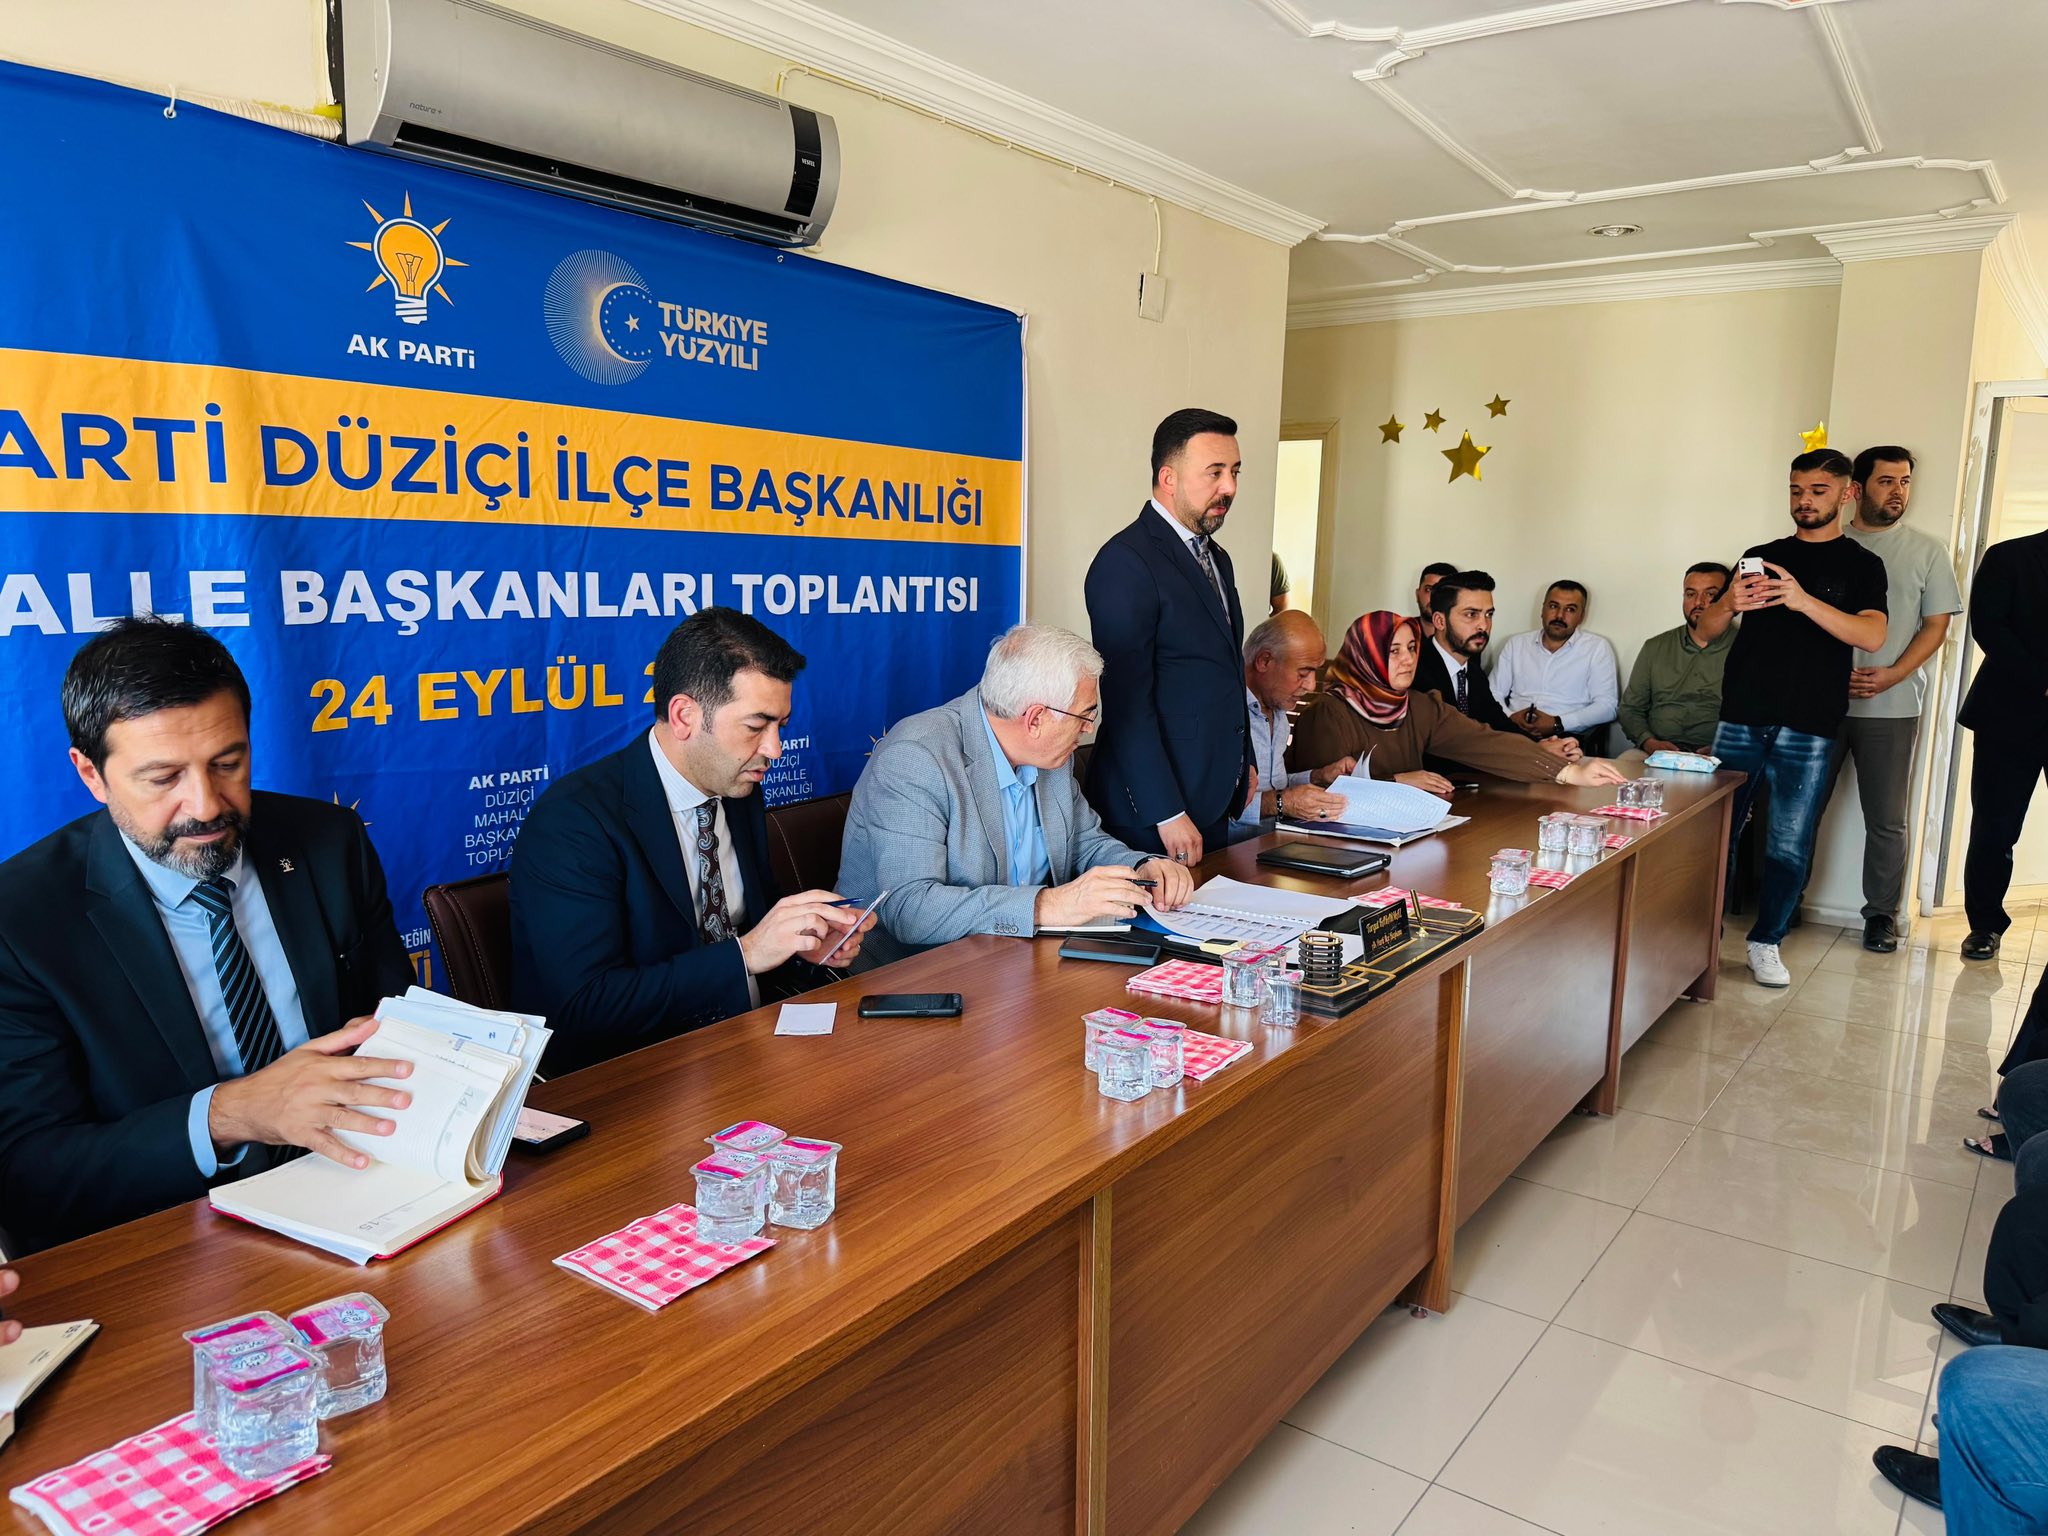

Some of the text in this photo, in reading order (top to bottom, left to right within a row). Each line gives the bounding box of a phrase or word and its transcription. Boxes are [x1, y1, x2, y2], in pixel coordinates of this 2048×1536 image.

[347, 334, 389, 359] AK
[659, 330, 759, 371] YÜZYILI
[0, 402, 983, 527] ARTİ DÜZİÇİ İLÇE BAŞKANLIĞI
[0, 569, 979, 637] ALLE BAŞKANLARI TOPLANTISI
[310, 675, 393, 732] 24
[418, 655, 624, 721] EYLÜL
[780, 735, 810, 751] ARTİ
[469, 764, 549, 790] AK PARTİ
[485, 786, 535, 808] DÜZİÇİ
[764, 781, 813, 802] ŞKANLIĞI
[475, 806, 530, 828] MAHAL
[465, 826, 520, 848] BAŞKA
[466, 846, 514, 866] TOPLA
